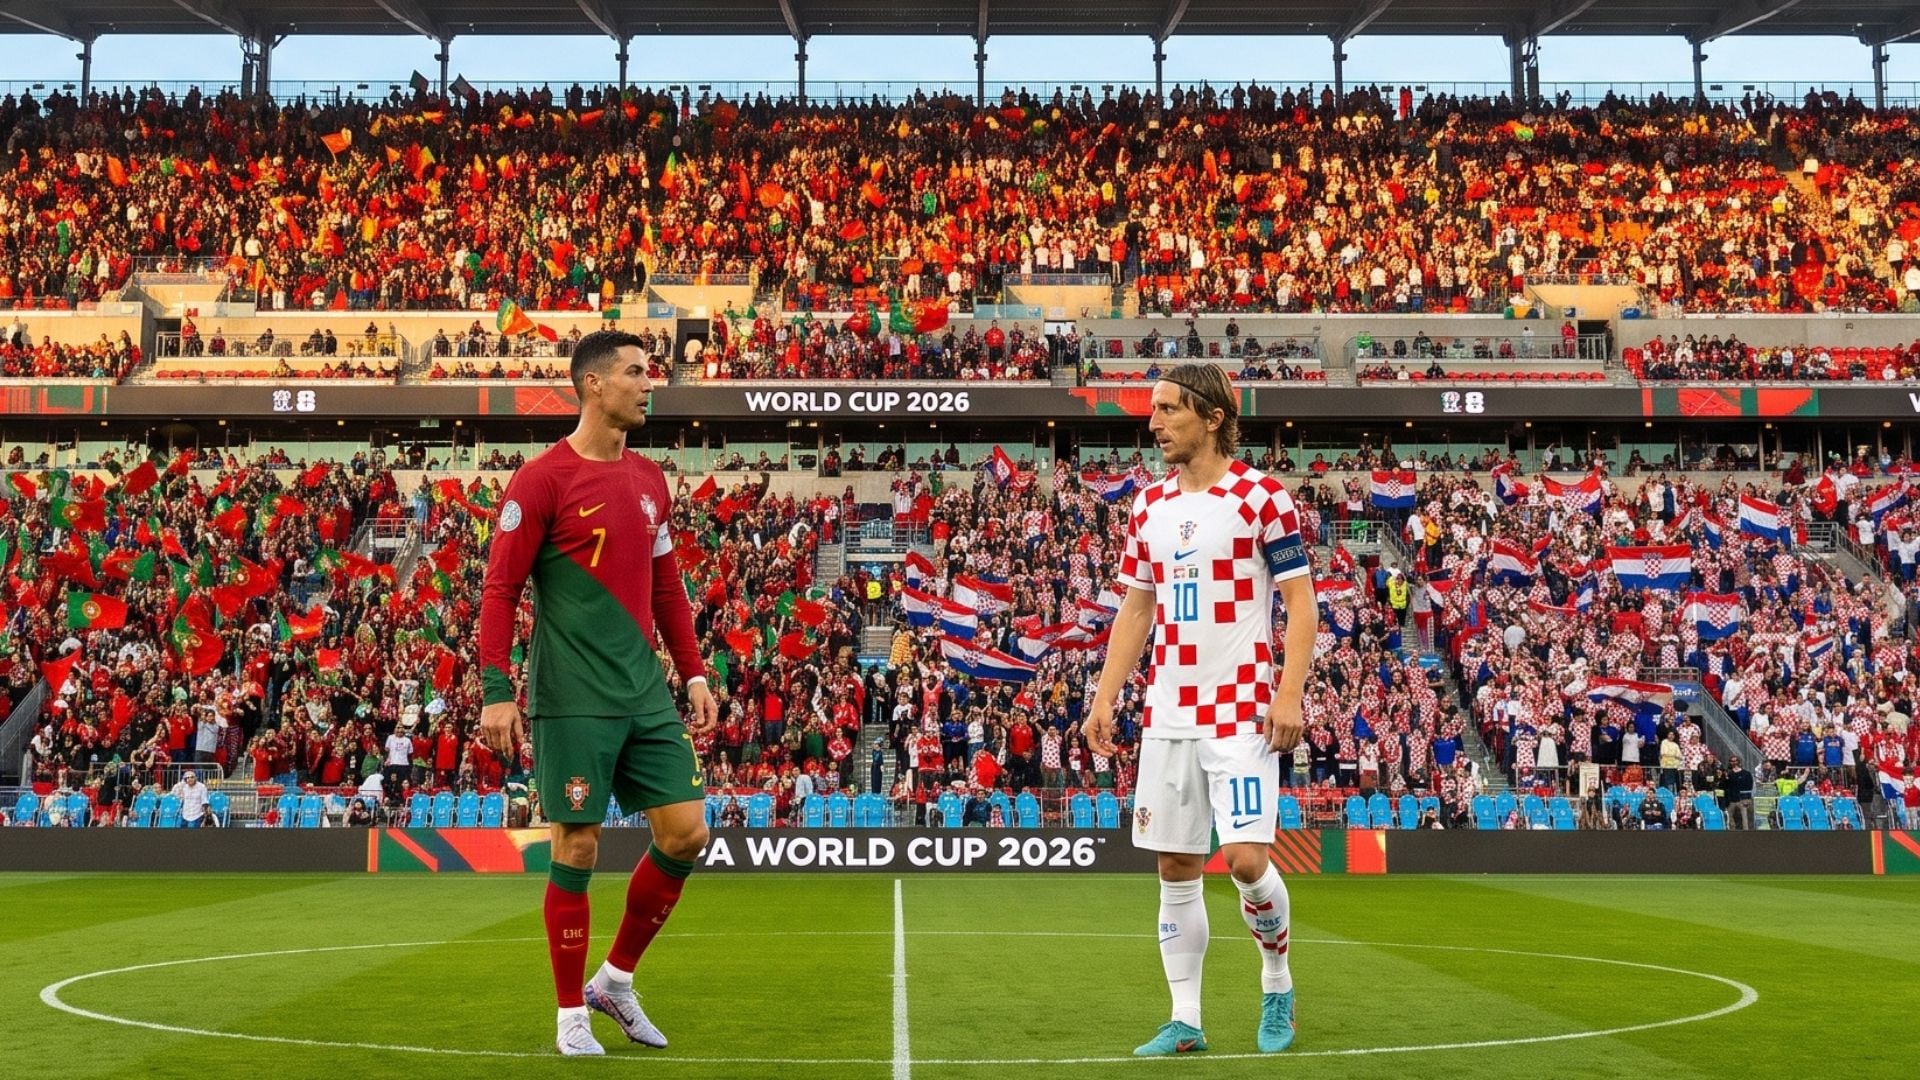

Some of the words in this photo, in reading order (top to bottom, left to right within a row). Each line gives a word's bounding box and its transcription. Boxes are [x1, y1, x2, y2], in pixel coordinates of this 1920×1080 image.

[744, 391, 842, 412] WORLD
[848, 391, 901, 412] CUP
[906, 391, 970, 412] 2026
[590, 527, 606, 567] 7
[1173, 582, 1198, 621] 10
[1229, 776, 1262, 816] 10
[745, 837, 895, 866] WORLD
[907, 837, 988, 866] CUP
